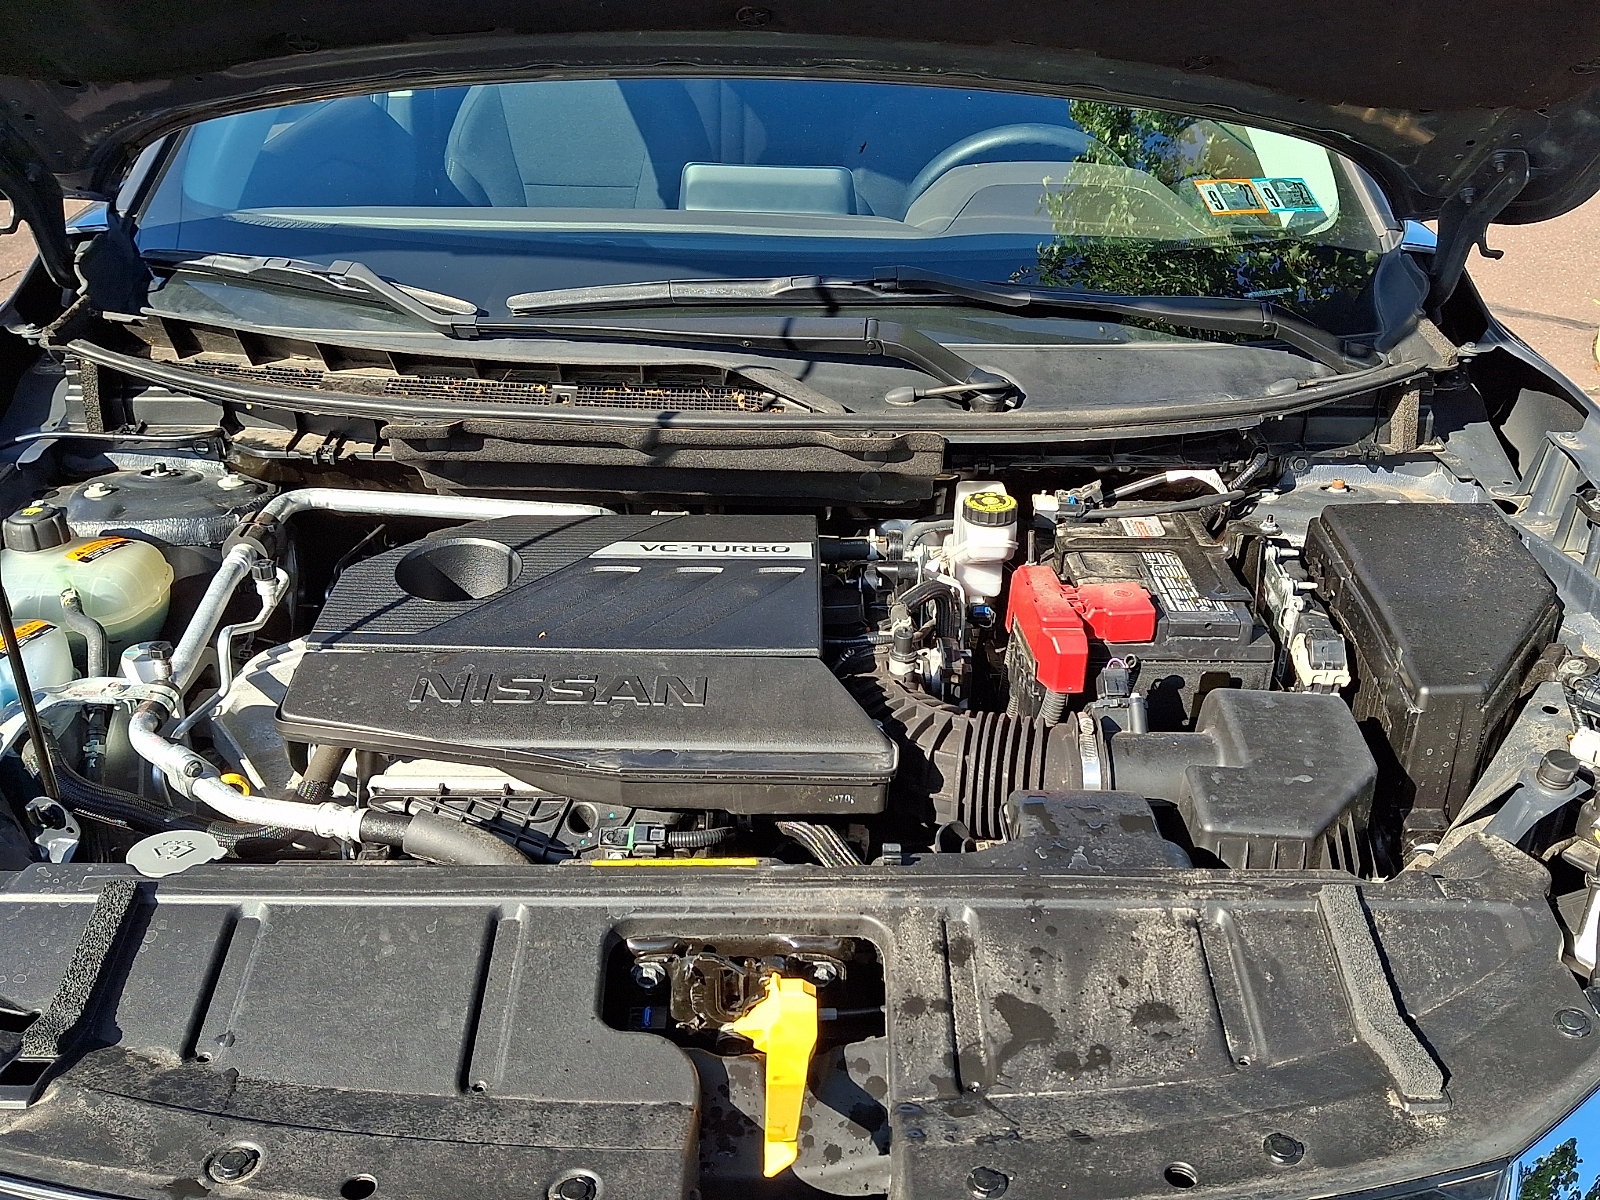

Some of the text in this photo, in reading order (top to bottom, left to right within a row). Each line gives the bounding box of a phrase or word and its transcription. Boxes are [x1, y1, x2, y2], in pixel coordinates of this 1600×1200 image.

[1208, 184, 1260, 211] 9 27
[1263, 187, 1280, 208] 9
[640, 544, 791, 553] VC-TURBO
[408, 673, 708, 707] NISSAN
